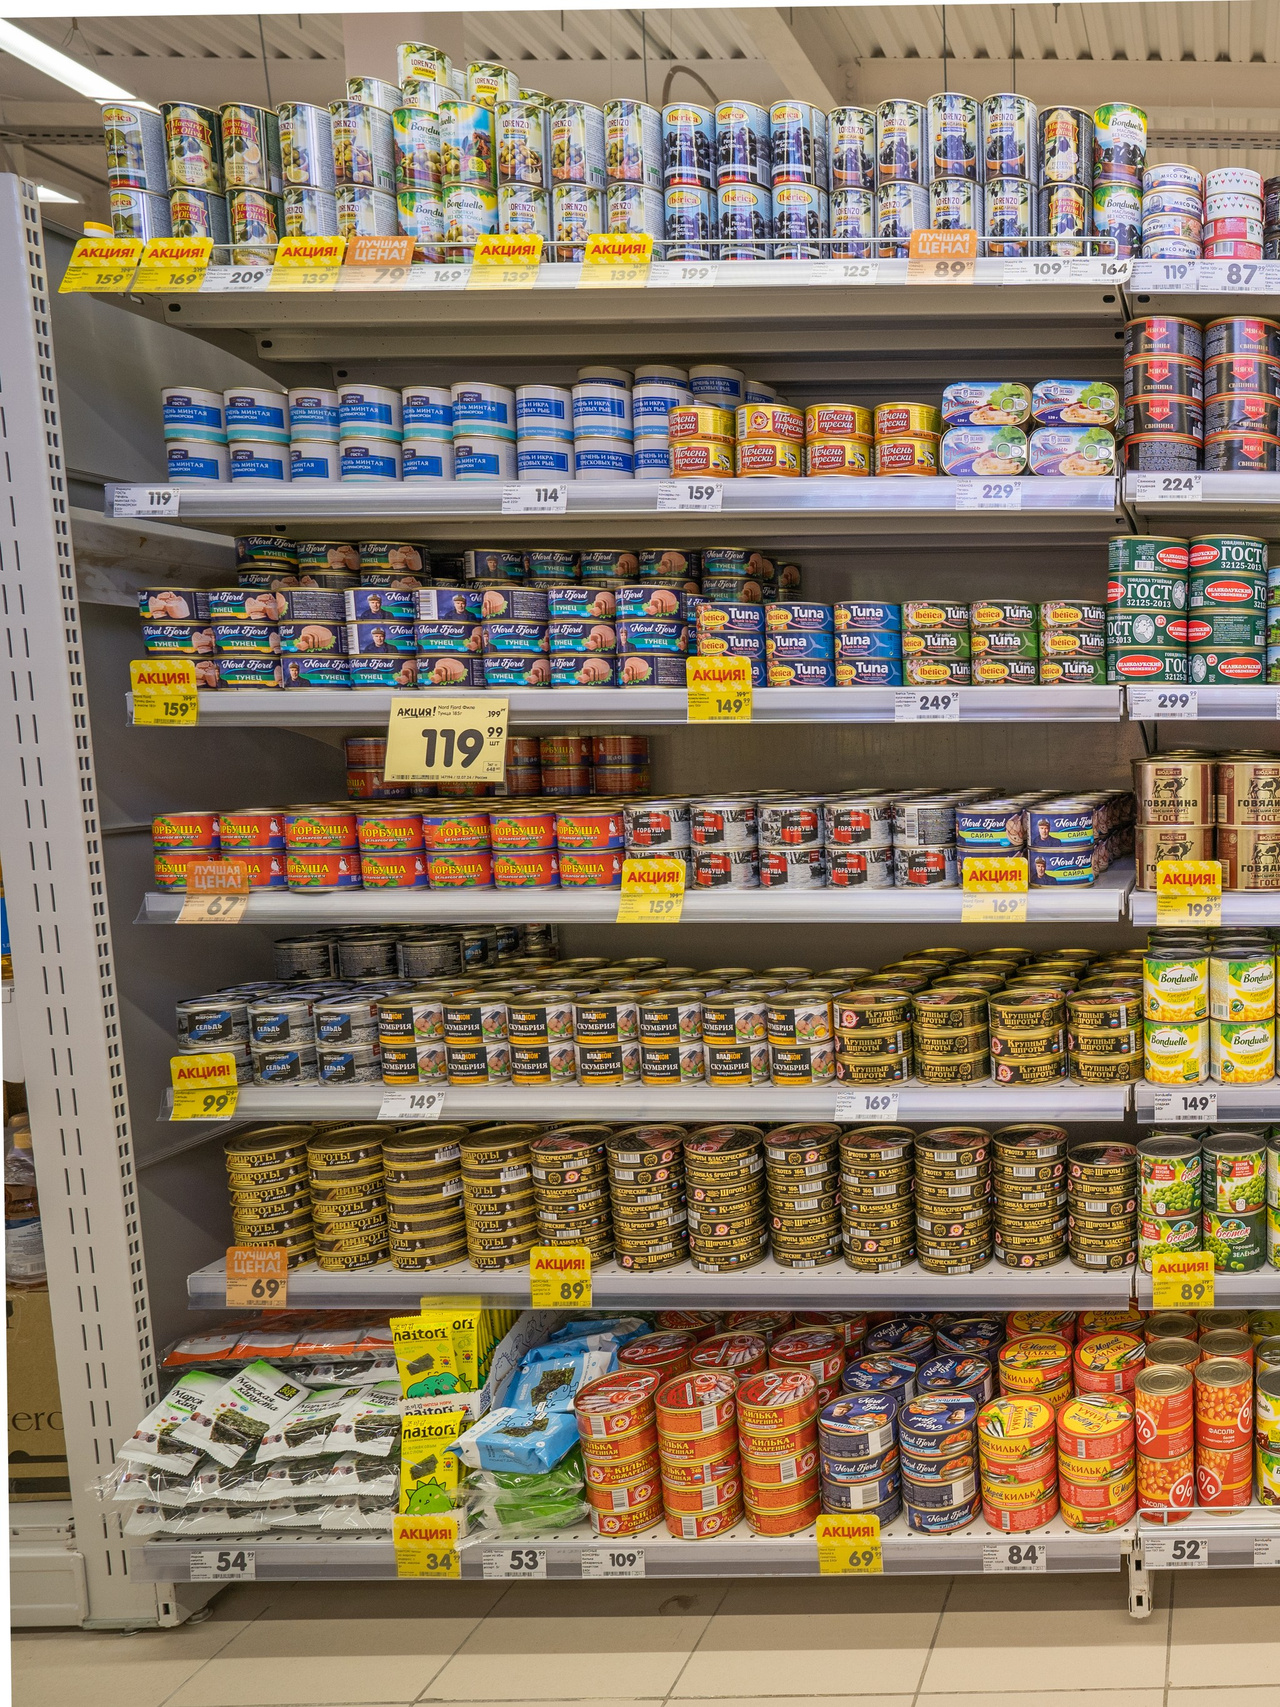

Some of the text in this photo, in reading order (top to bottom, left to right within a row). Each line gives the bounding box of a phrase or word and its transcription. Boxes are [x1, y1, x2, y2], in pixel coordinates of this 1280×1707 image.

[446, 198, 483, 209] Bonduelle
[919, 232, 970, 243] ЛУЧШАЯ
[77, 245, 134, 260] АКЦИЯ!
[281, 244, 338, 258] АКЦИЯ!
[918, 242, 970, 255] ЦЕНА!
[729, 608, 759, 619] Tuna
[915, 611, 943, 619] Ibérica
[222, 660, 244, 669] Nord
[137, 672, 190, 686] АКЦИЯ!
[692, 670, 746, 681] АКЦИЯ!
[397, 707, 436, 717] АКЦИЯ!
[421, 726, 502, 768] 119 99
[969, 871, 1022, 882] АКЦИЯ!
[1163, 873, 1215, 885] АКЦИЯ!
[1160, 971, 1199, 983] Bonduelle
[710, 1062, 749, 1071] СКУМБРИЯ
[535, 1259, 585, 1270] АКЦИЯ!
[1158, 1262, 1209, 1274] АКЦИЯ!
[394, 1326, 448, 1342] naitori
[822, 1526, 874, 1538] АКЦИЯ!
